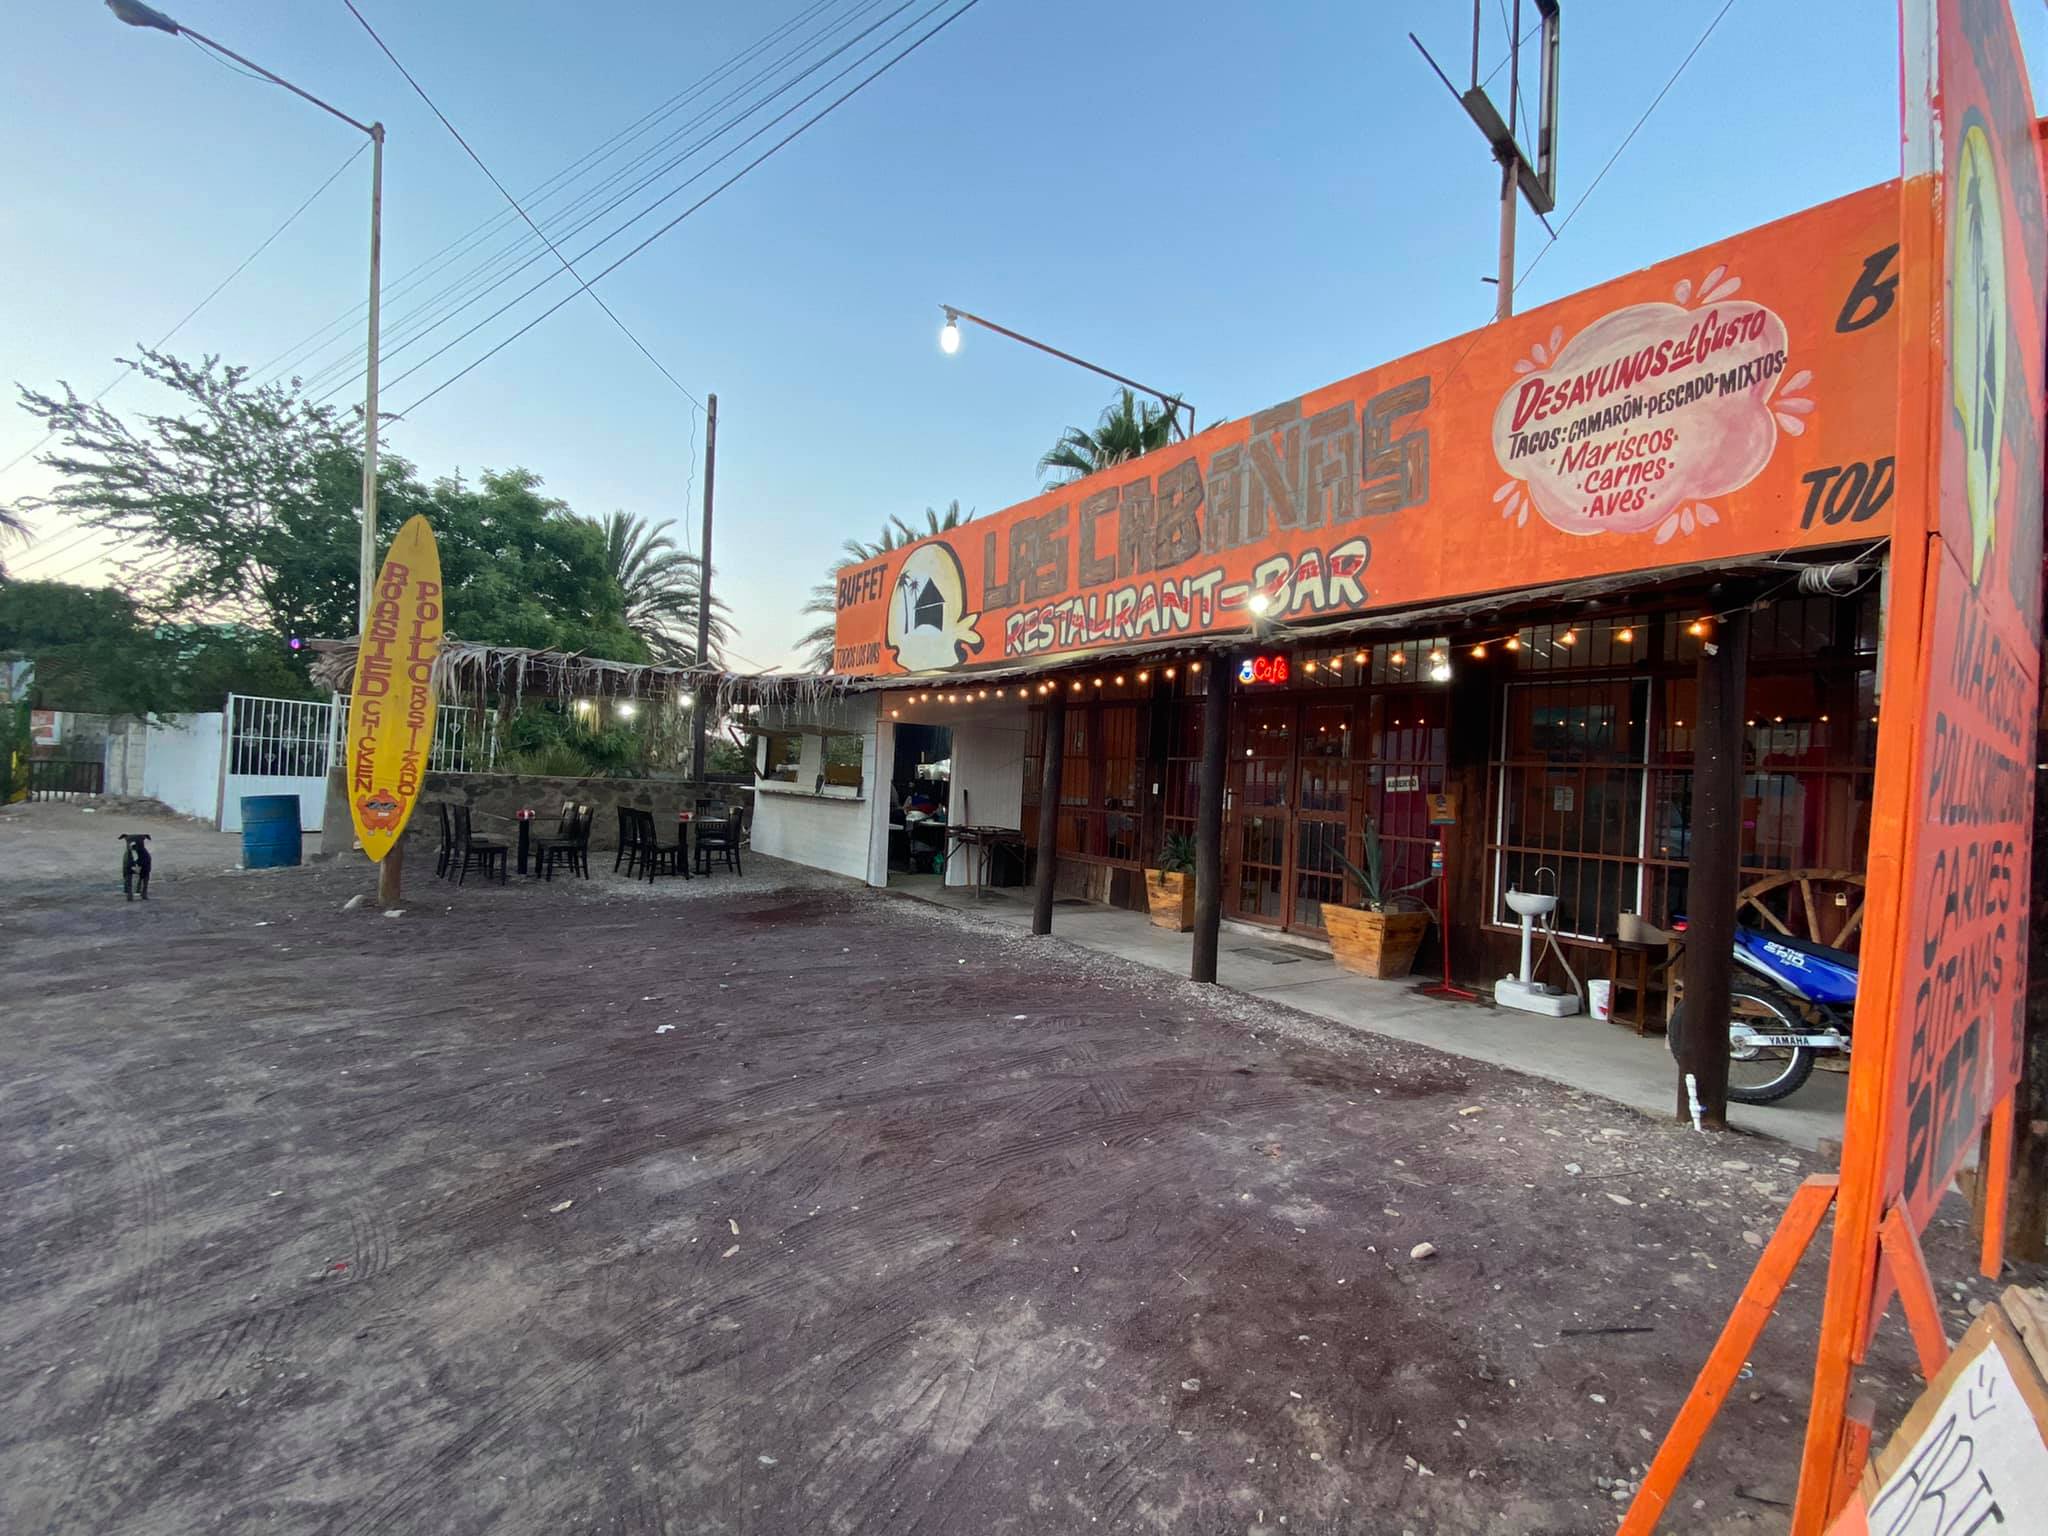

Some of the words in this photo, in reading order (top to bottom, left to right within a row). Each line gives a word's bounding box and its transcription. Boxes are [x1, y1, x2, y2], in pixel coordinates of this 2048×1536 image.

[837, 563, 889, 610] BUFFET
[983, 504, 1068, 612] LAS
[357, 561, 410, 698] ROASTED
[406, 580, 440, 685] POLLO
[1253, 655, 1289, 684] Café
[354, 699, 382, 793] CHICKEN
[1923, 840, 2014, 972] CARNES
[1769, 1035, 1809, 1045] YAMAHA
[1906, 922, 2006, 1108] BOTANAS
[1902, 1015, 1980, 1203] PIZZ
